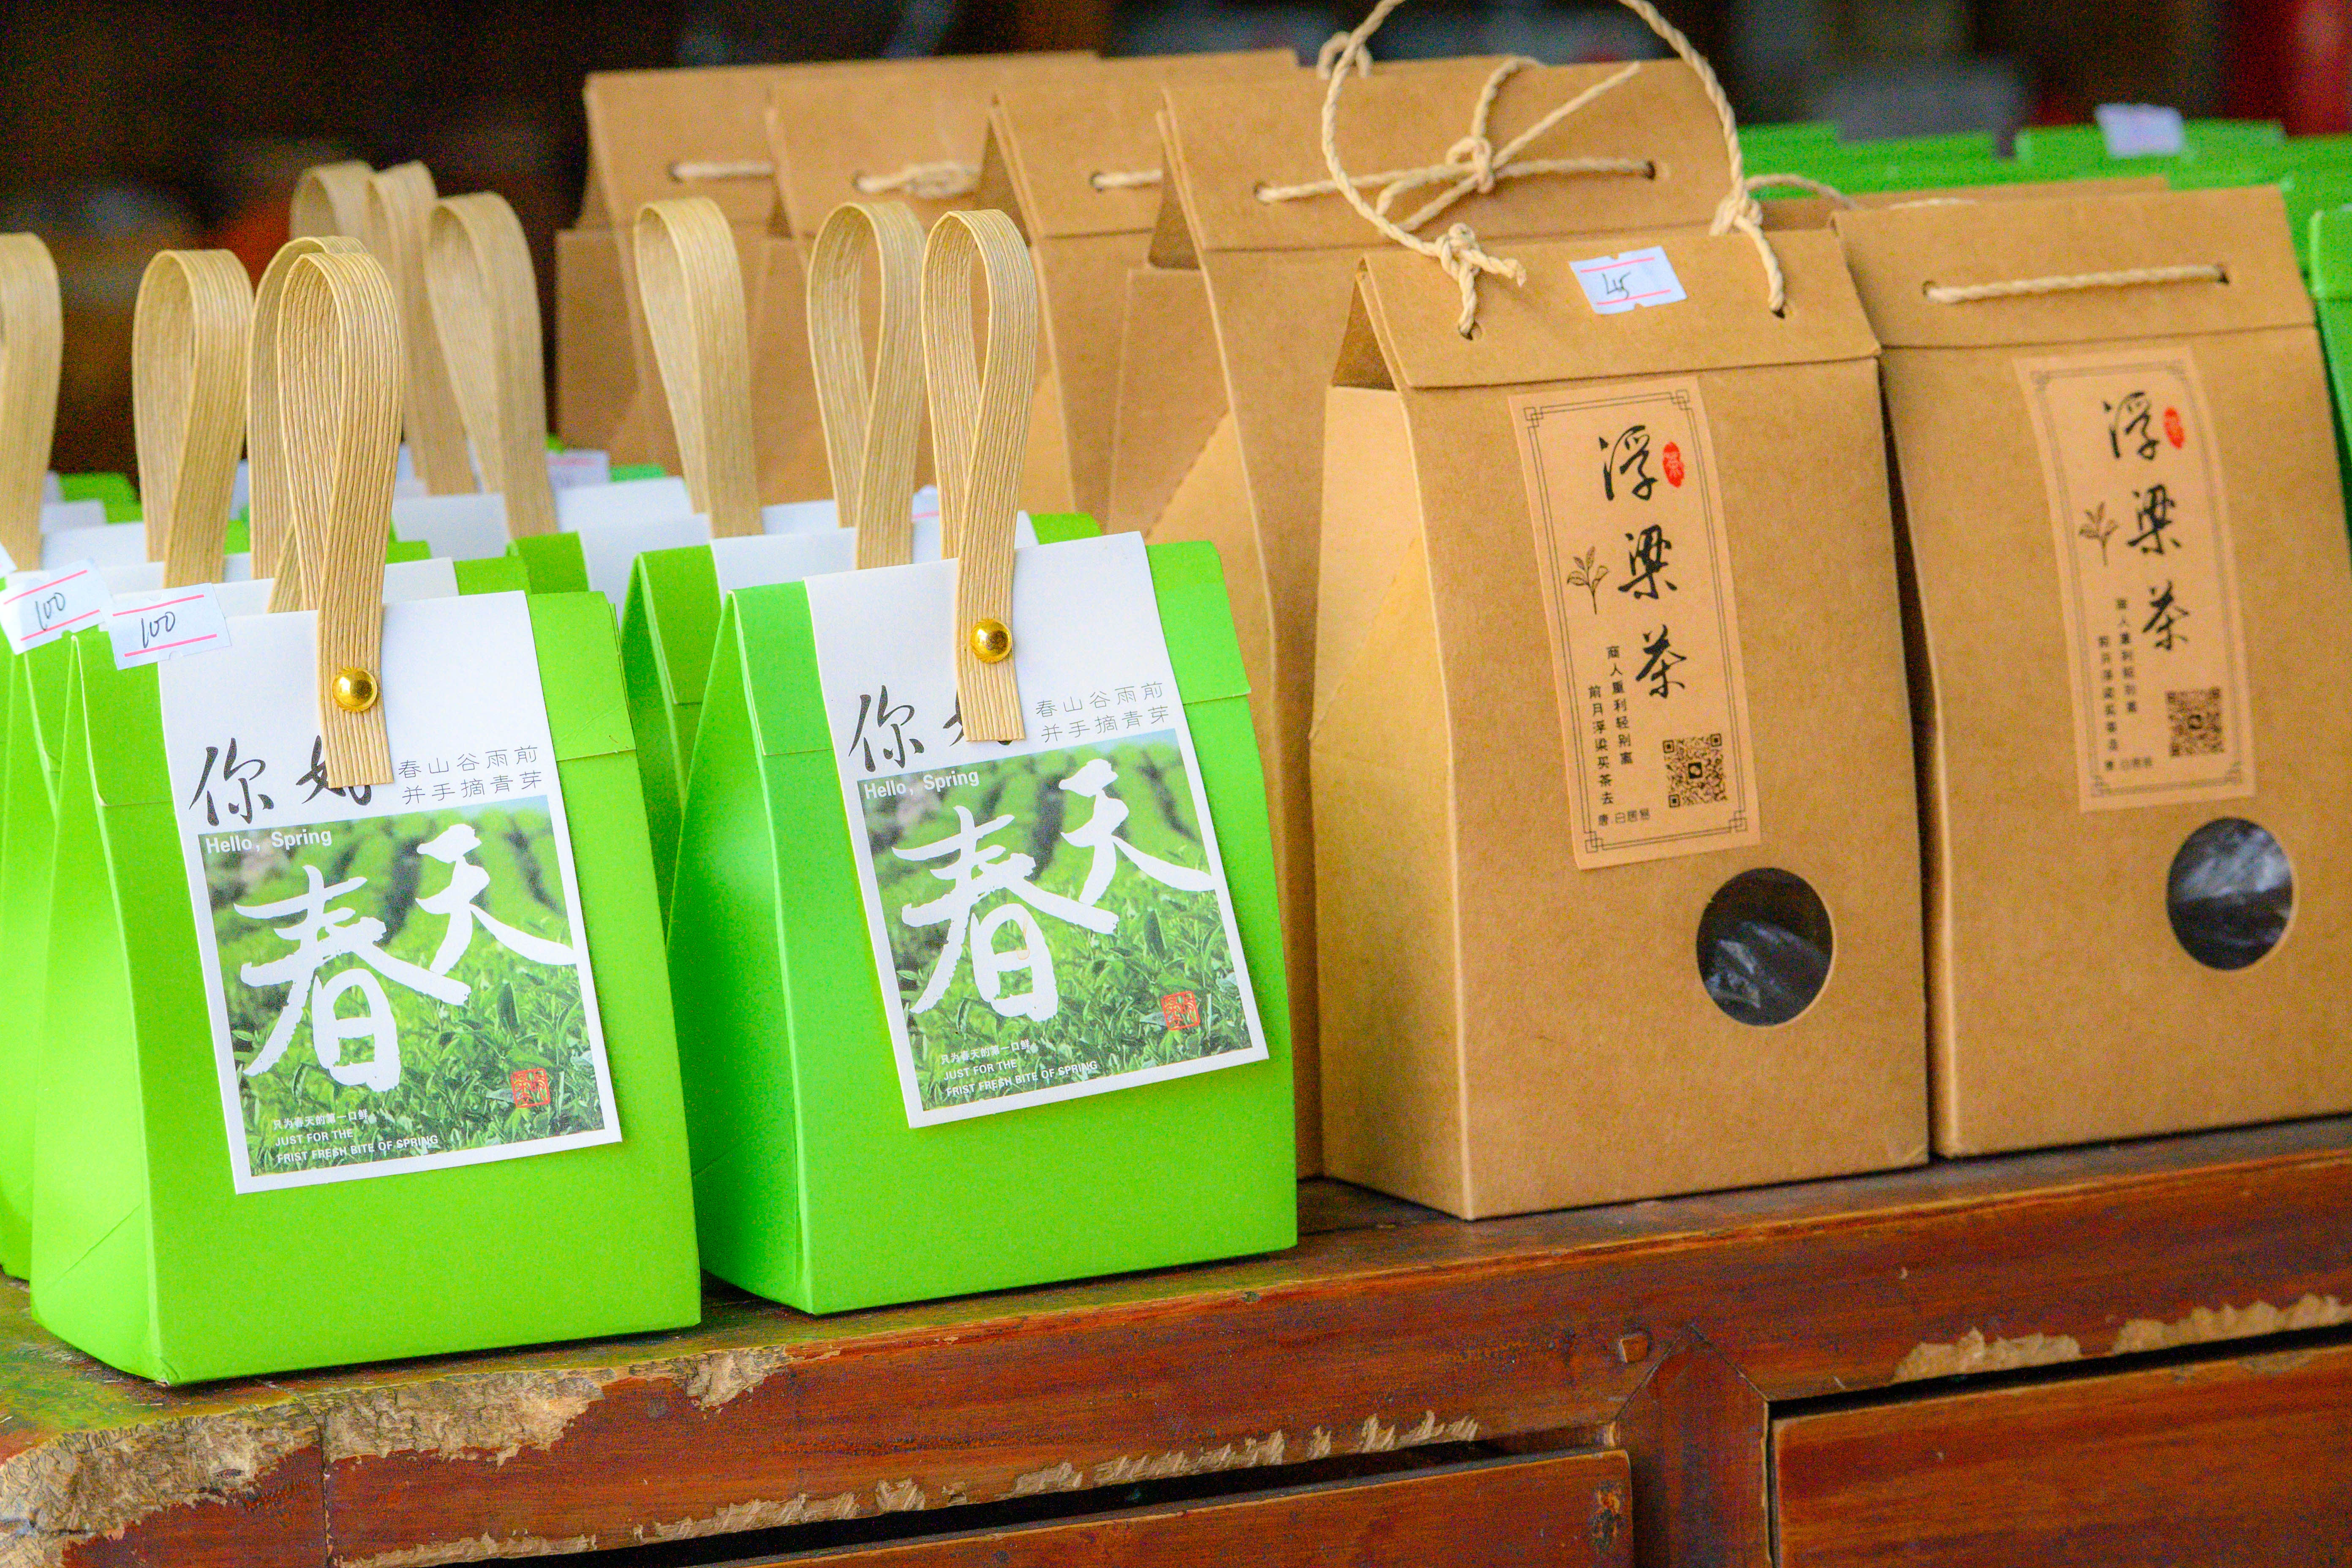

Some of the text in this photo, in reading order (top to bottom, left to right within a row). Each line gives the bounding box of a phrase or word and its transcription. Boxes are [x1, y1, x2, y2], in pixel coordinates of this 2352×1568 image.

[1598, 425, 1687, 699] 浮梁茶
[35, 592, 65, 631] 100
[141, 611, 176, 648] 100
[1036, 681, 1164, 717] 春山谷雨前
[1041, 705, 1170, 743] 并手摘青芽
[398, 746, 538, 779] 春山谷雨前
[402, 771, 542, 805] 并手摘青芽
[864, 770, 980, 799] Hello, Spring
[205, 829, 332, 854] Hello, Spring
[892, 758, 1216, 1023] 春天
[233, 824, 577, 1093] 春天
[941, 1039, 1030, 1064] 只为春天的第一口鲜
[944, 1059, 1017, 1081] JUST FOR THE
[946, 1061, 1098, 1097] FRIST FRESH BITE OF SPRING
[273, 1108, 369, 1130] 只为春天的第一口鲜
[275, 1128, 354, 1147] JUST FOR THE
[277, 1135, 439, 1164] FRIST FRESH BITE OF SPRING
